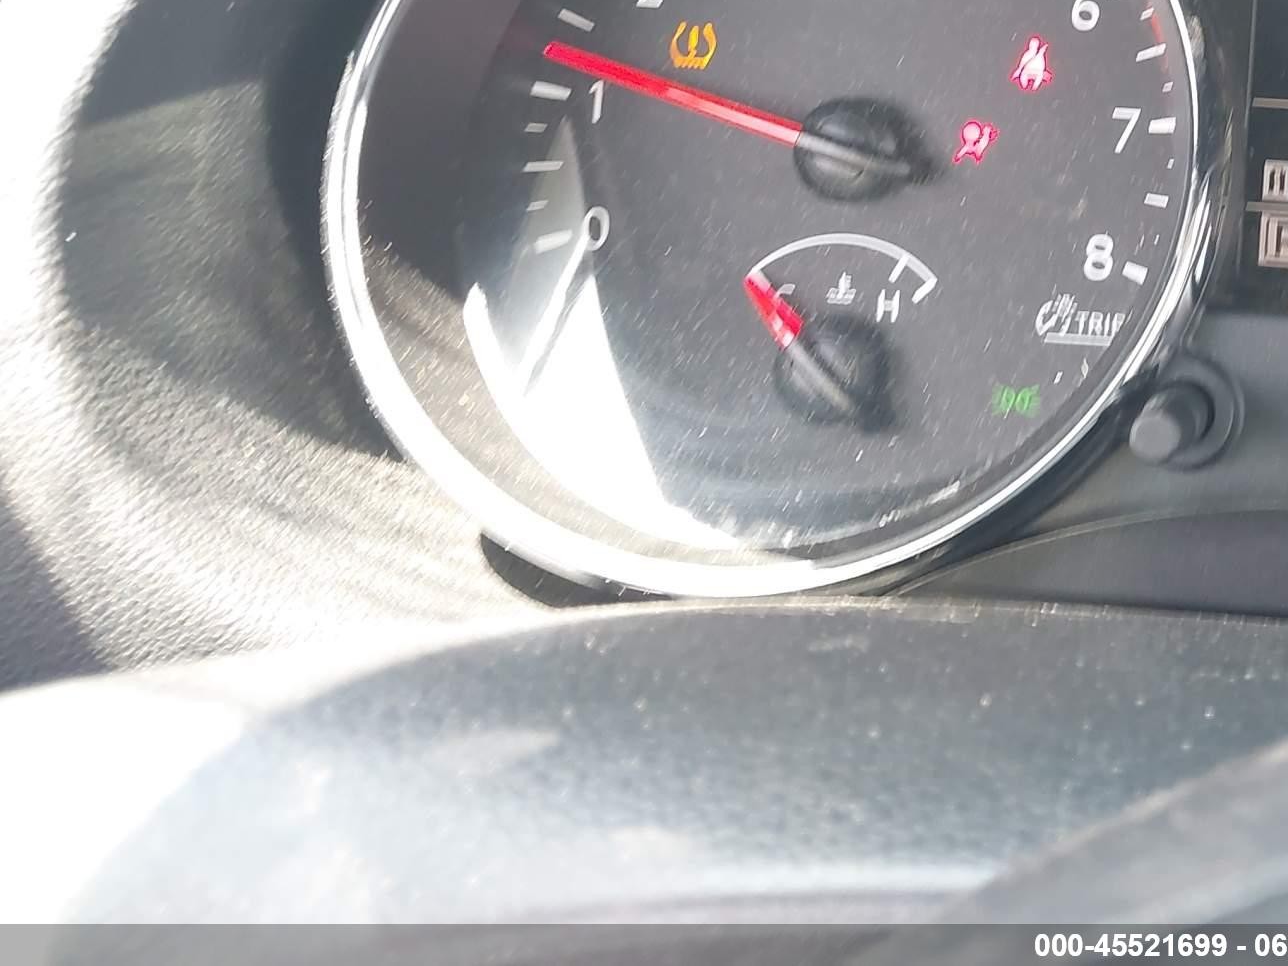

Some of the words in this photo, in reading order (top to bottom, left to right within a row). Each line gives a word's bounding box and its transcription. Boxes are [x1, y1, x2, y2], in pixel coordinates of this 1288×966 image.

[588, 79, 604, 124] 1
[1111, 106, 1141, 154] 7
[582, 206, 611, 252] 0
[1083, 234, 1115, 282] 8
[876, 289, 901, 323] H
